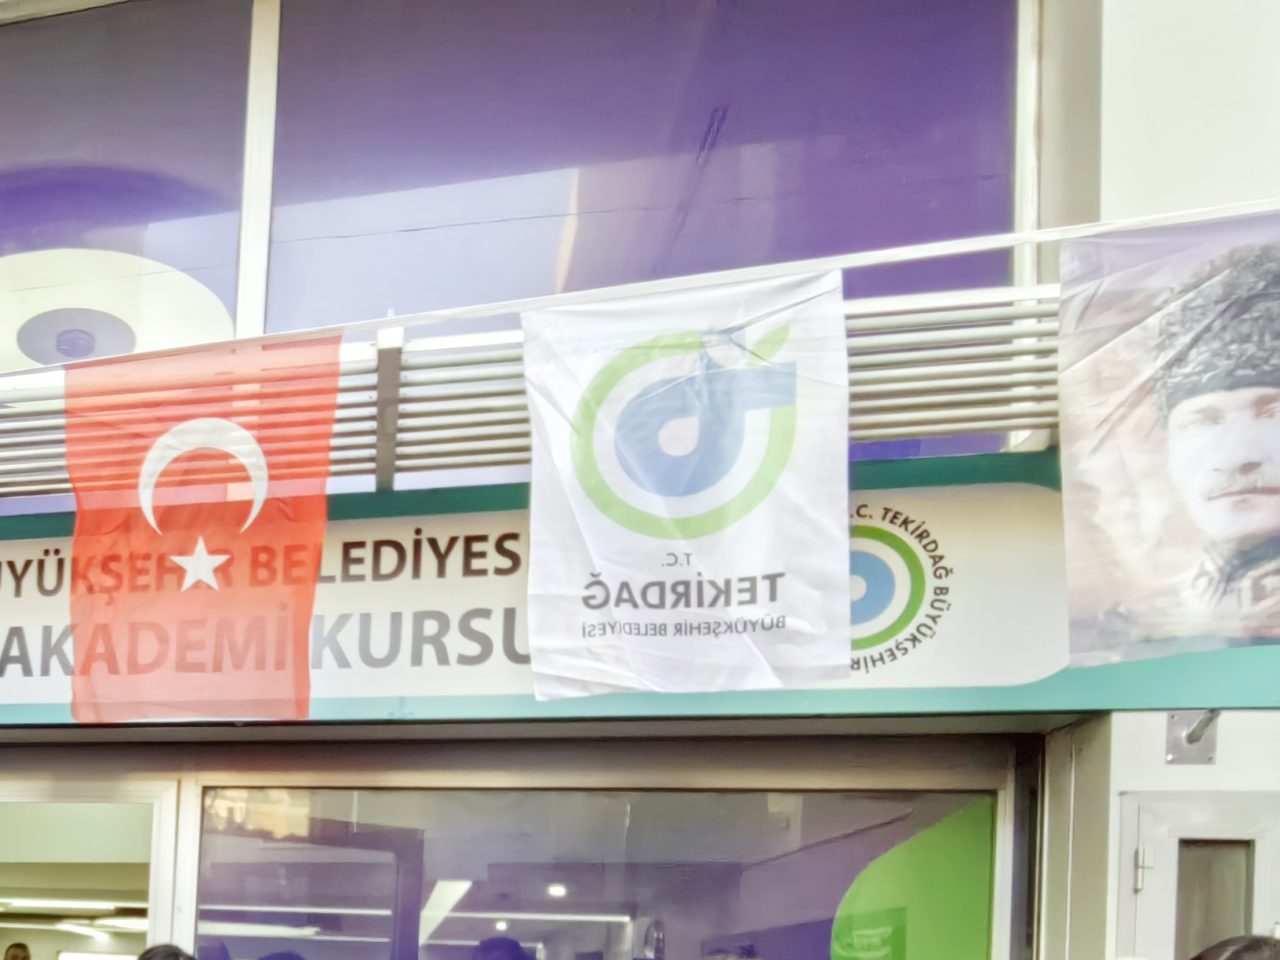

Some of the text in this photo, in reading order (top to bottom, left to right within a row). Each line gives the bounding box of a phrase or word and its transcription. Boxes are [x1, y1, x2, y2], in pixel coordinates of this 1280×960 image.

[250, 527, 522, 588] BELEDİYES
[850, 503, 954, 674] .C. TEKİRDAĞ BÜYÜKŞEHİR
